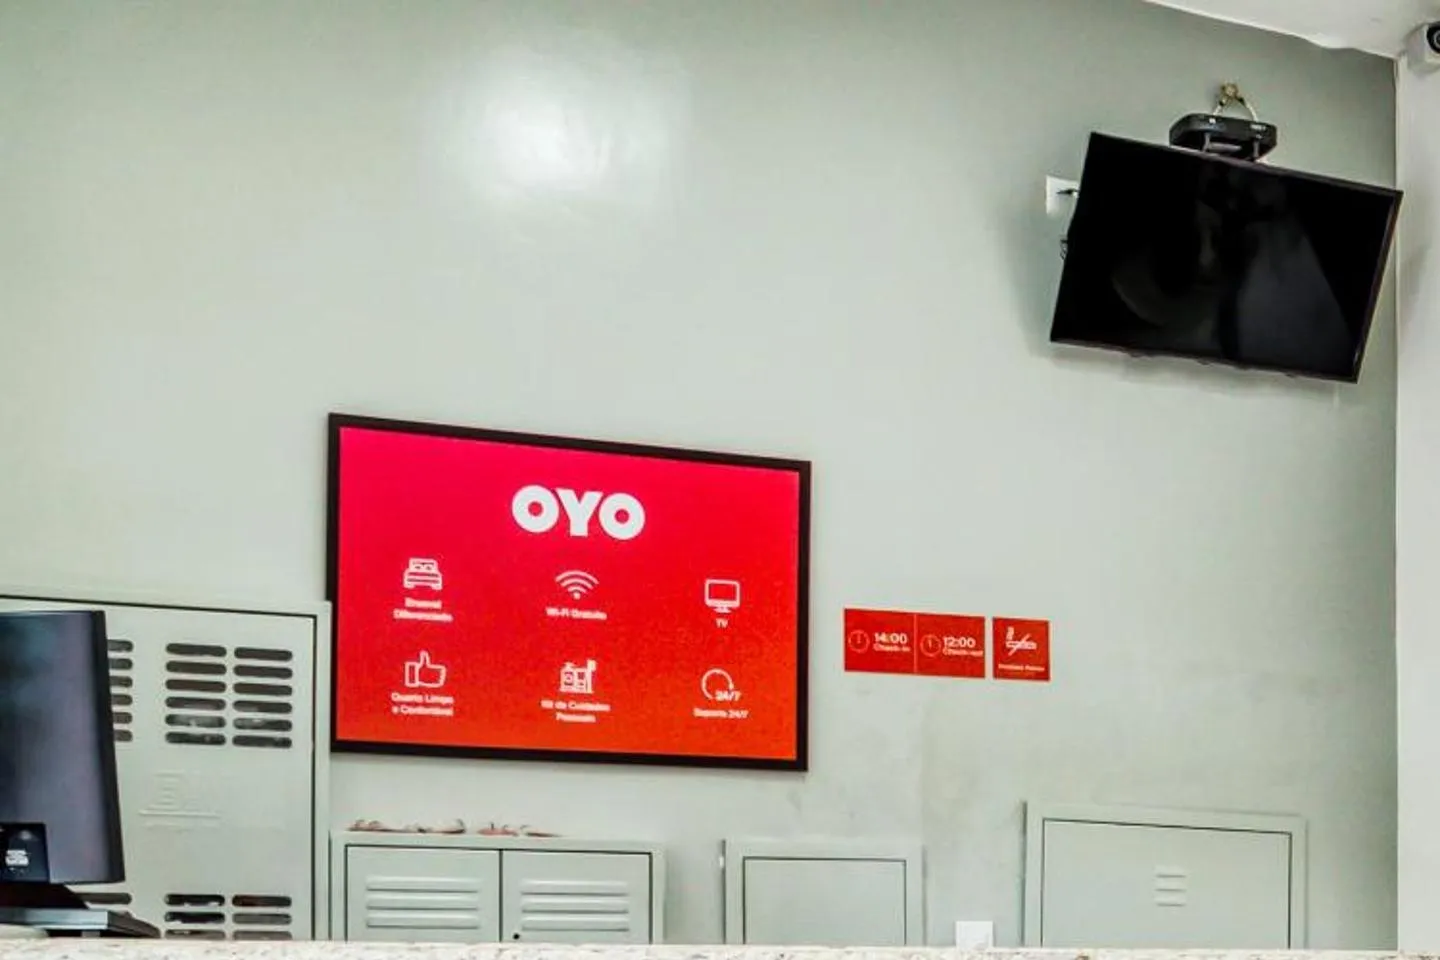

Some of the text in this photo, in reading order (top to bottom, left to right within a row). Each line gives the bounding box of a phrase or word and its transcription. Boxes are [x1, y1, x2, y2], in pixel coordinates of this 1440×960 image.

[511, 484, 646, 540] OYO
[545, 607, 570, 618] Wi-Fi
[715, 617, 729, 629] TV
[874, 632, 908, 645] 14:00
[943, 636, 977, 649] 12:00
